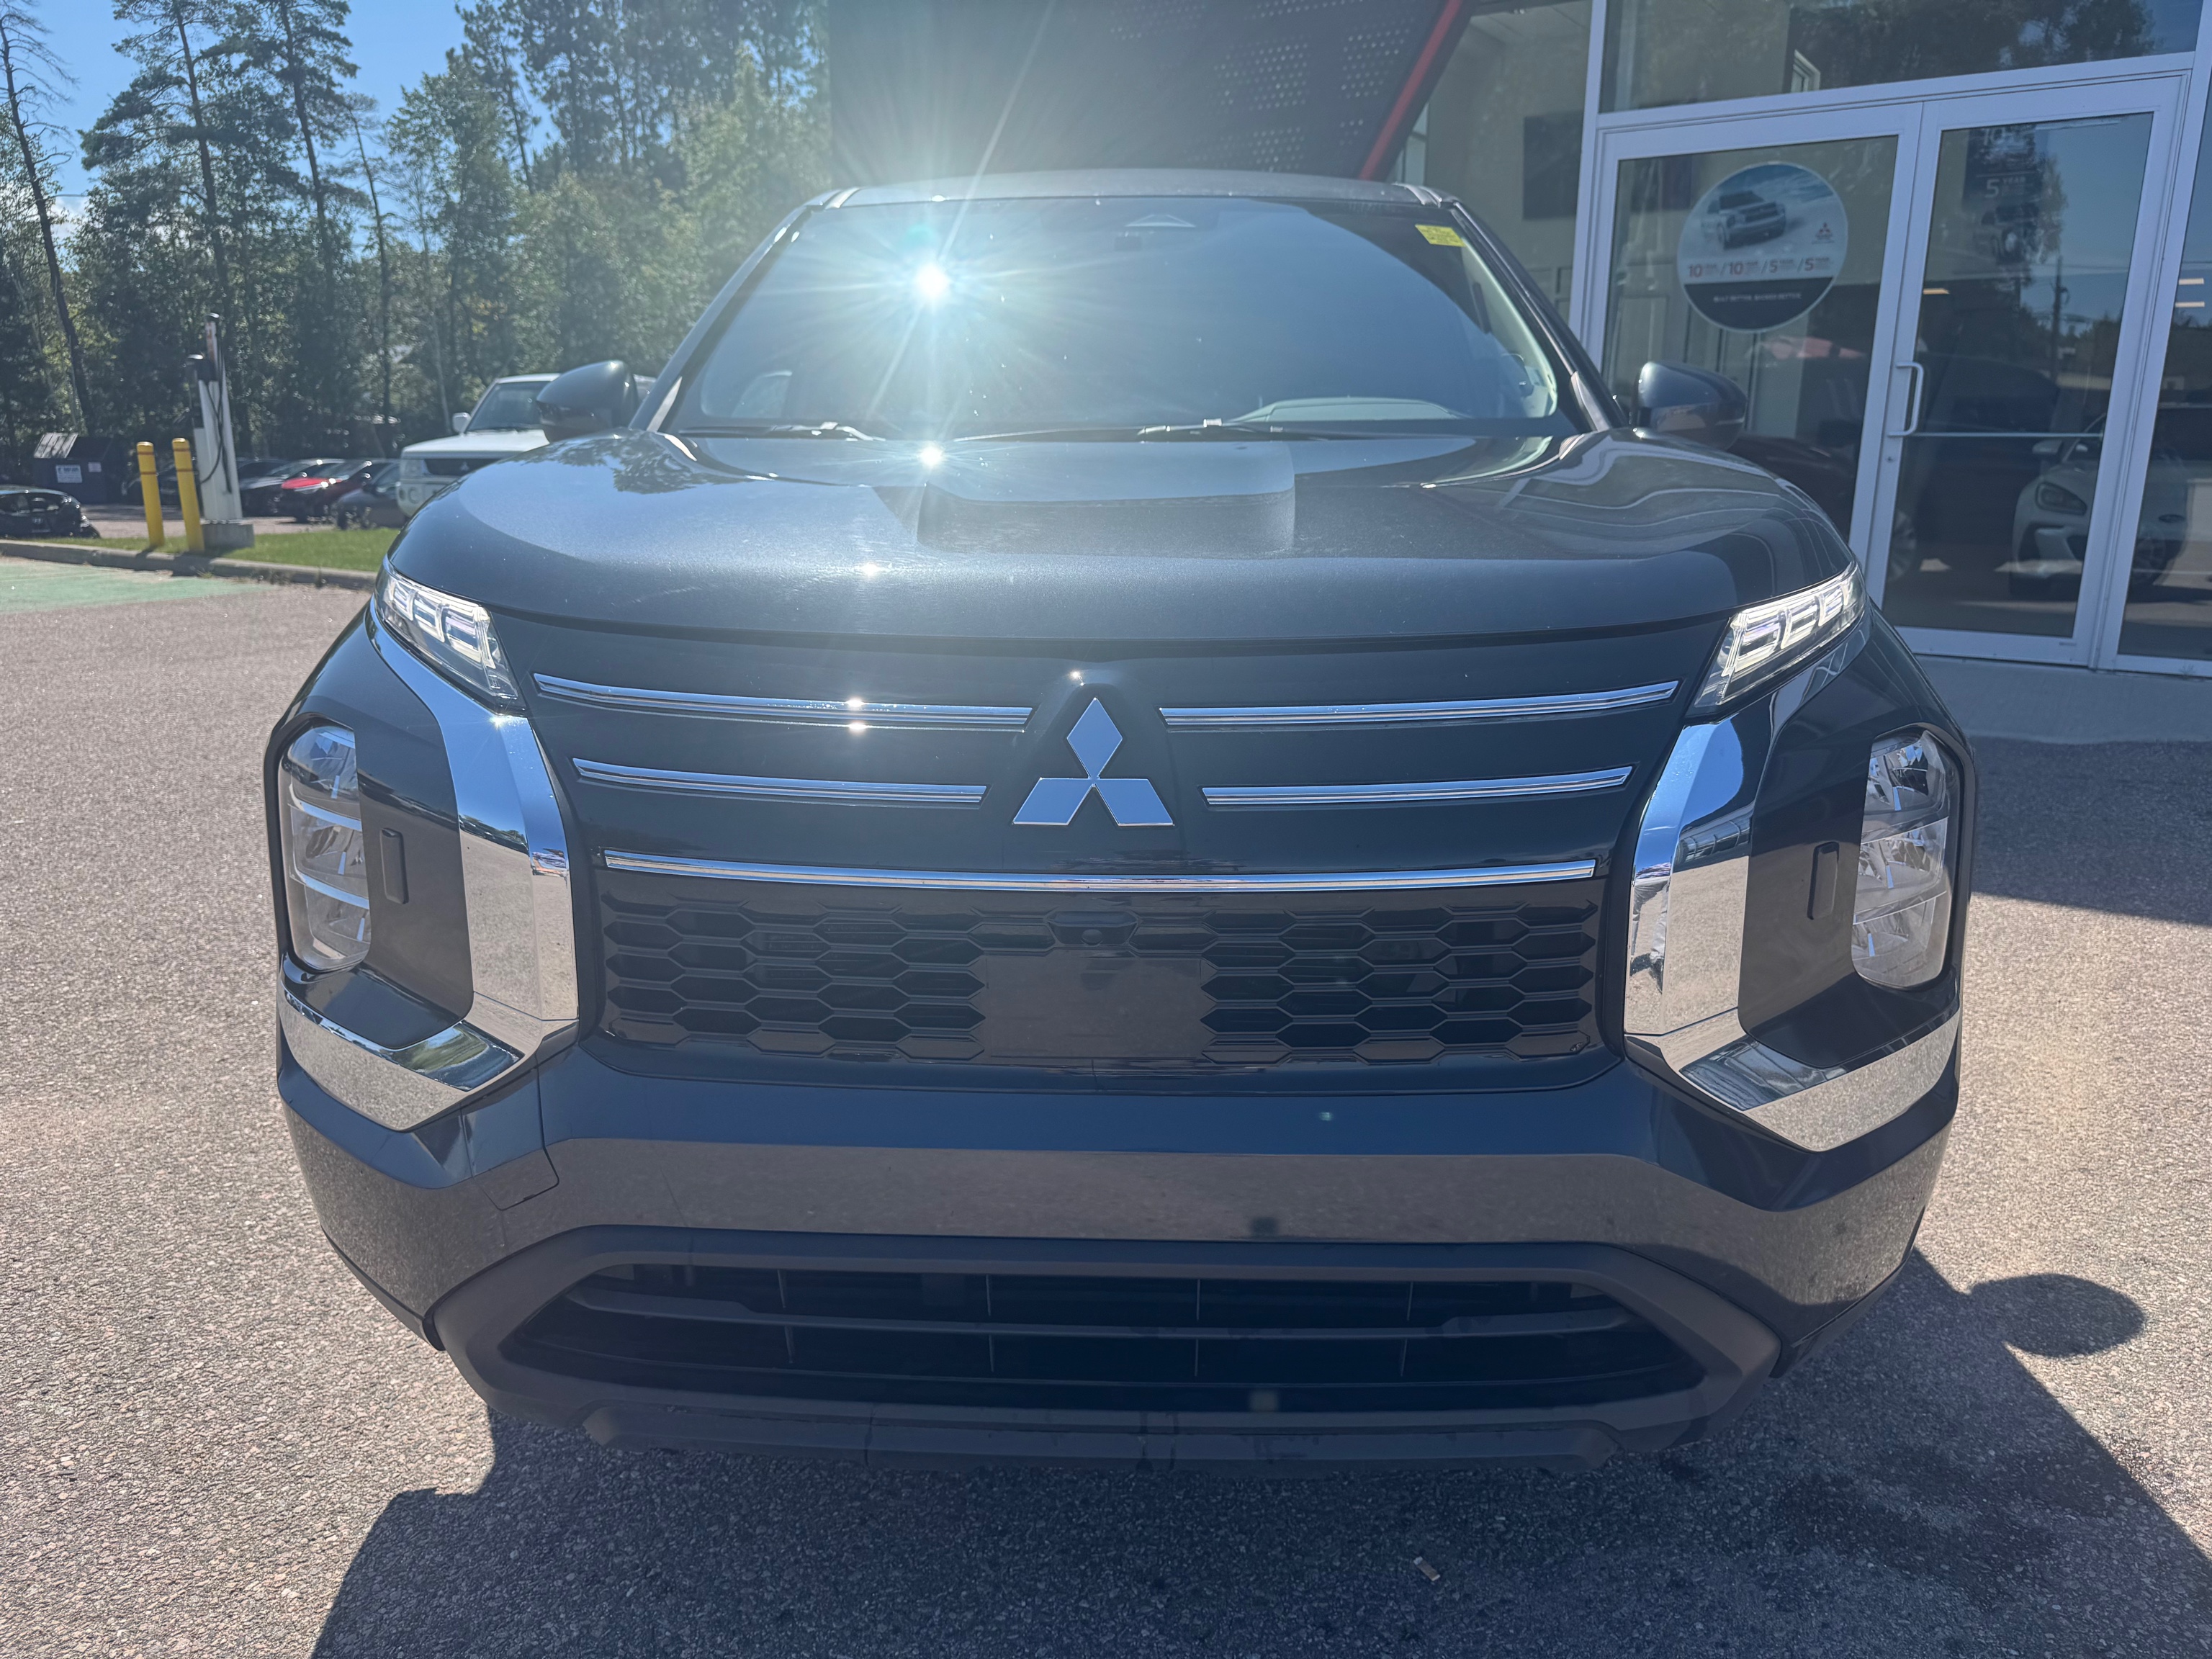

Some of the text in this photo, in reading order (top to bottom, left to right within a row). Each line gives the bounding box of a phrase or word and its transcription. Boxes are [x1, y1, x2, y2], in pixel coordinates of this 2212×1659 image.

[1985, 179, 2000, 198] 5
[1689, 264, 1703, 278] 10
[1729, 261, 1744, 275] 10
[1770, 260, 1778, 273] 5
[1804, 258, 1814, 271] 5
